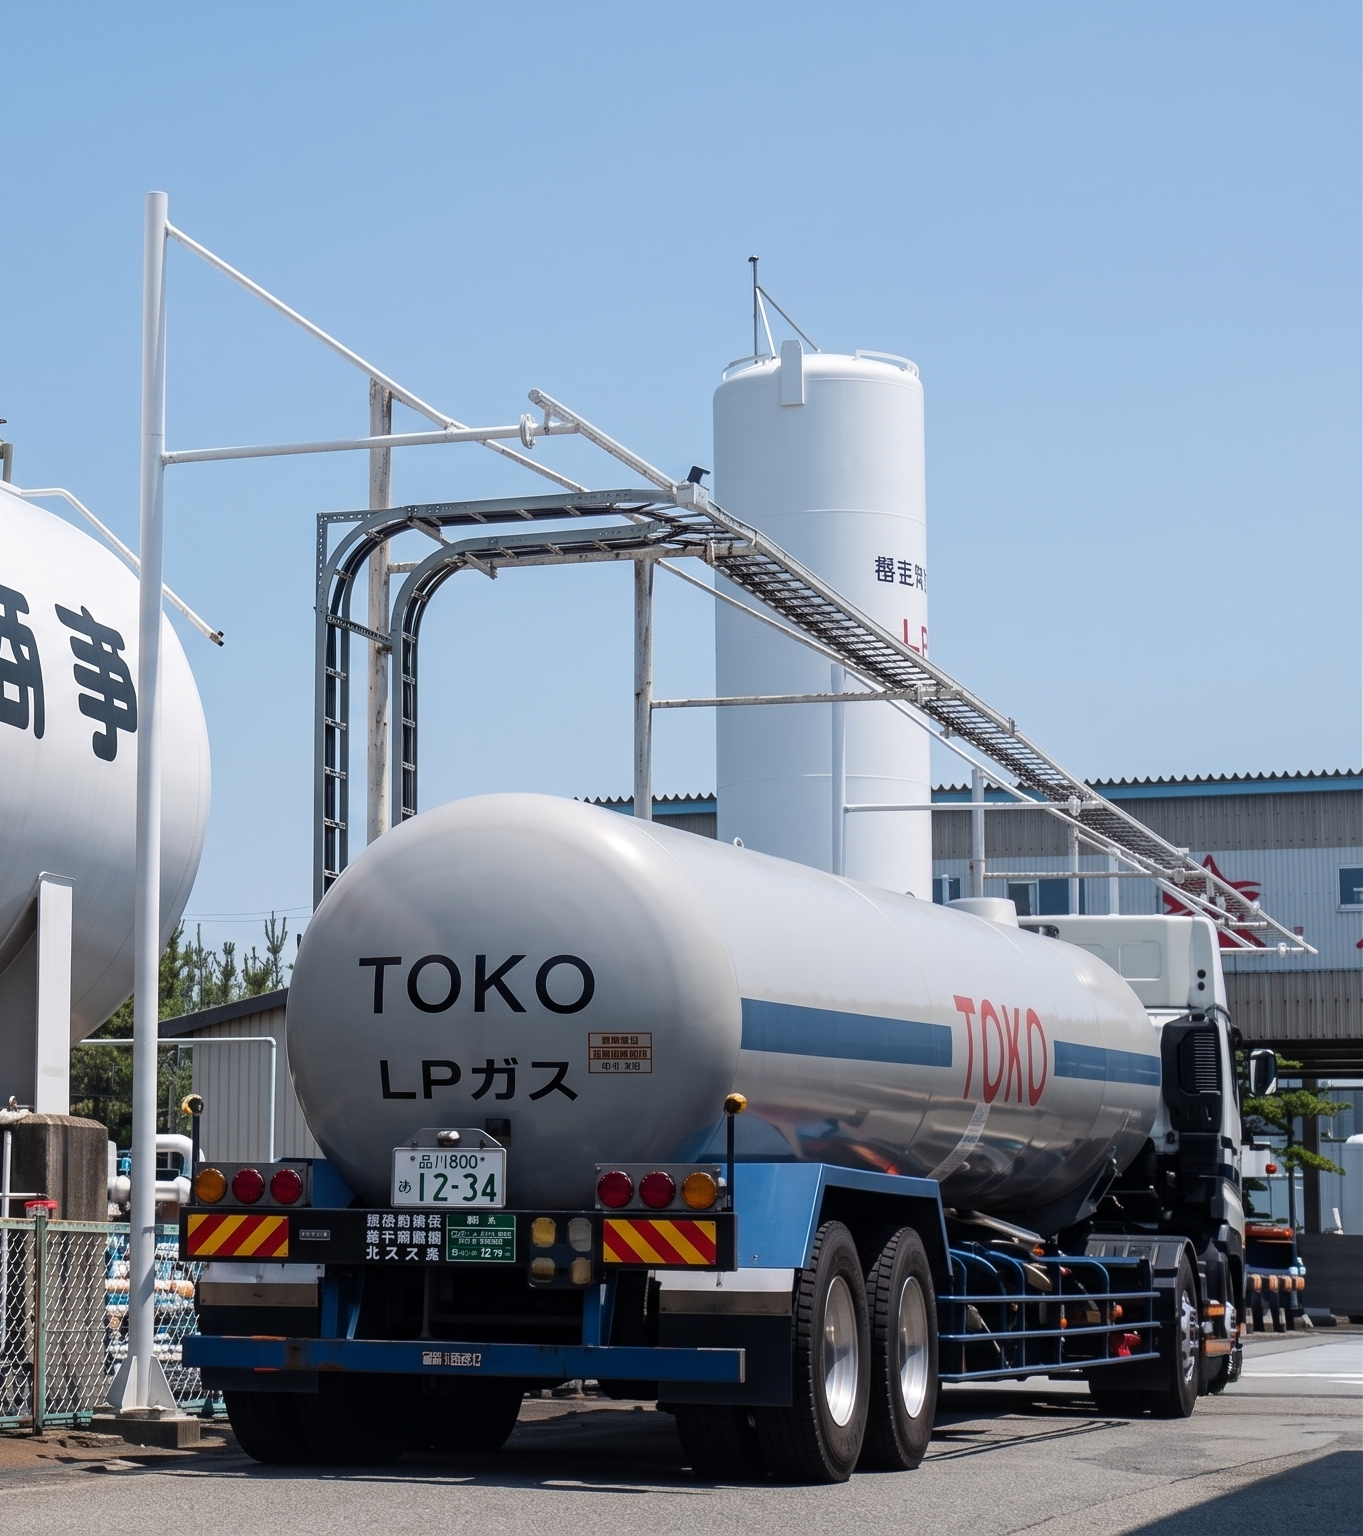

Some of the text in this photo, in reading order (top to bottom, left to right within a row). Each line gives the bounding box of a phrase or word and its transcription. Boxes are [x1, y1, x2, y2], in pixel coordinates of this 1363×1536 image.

[358, 953, 596, 1015] TOKO
[953, 994, 1048, 1107] TOKO
[379, 1057, 579, 1102] LPガス
[419, 1172, 497, 1202] 12-34
